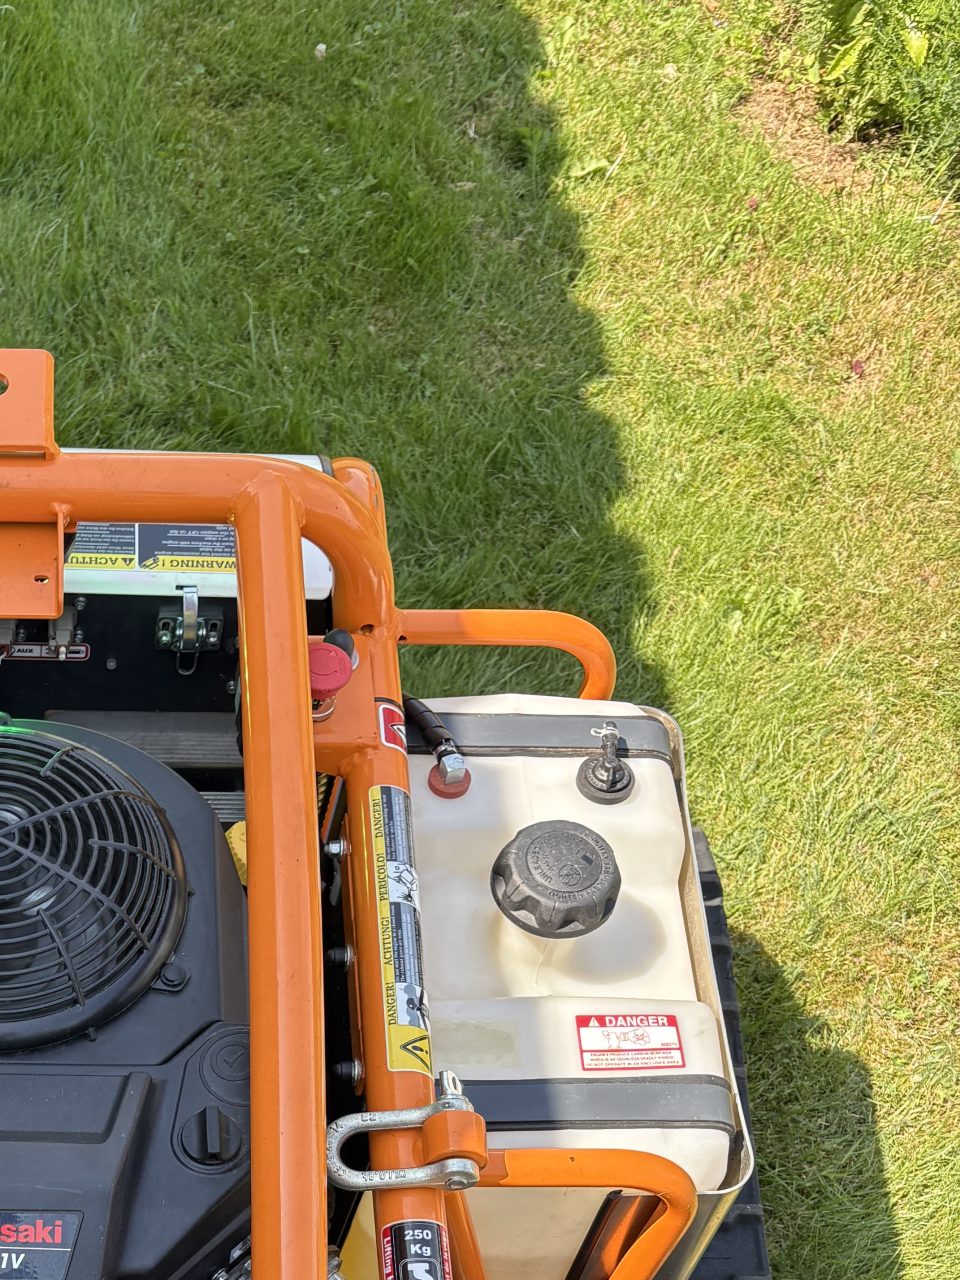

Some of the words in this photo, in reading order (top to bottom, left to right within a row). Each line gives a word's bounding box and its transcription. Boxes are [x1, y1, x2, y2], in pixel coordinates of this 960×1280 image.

[71, 556, 119, 565] ACHTU
[170, 559, 236, 568] WARNING
[372, 798, 384, 838] DANGER!
[376, 853, 388, 902] PERICOLO!
[381, 916, 393, 966] ACHTUNG!
[385, 981, 397, 1026] DANGER!
[605, 1015, 669, 1027] DANGER
[404, 1229, 432, 1241] 250
[383, 1236, 394, 1274] Lifting
[410, 1243, 431, 1257] Kg
